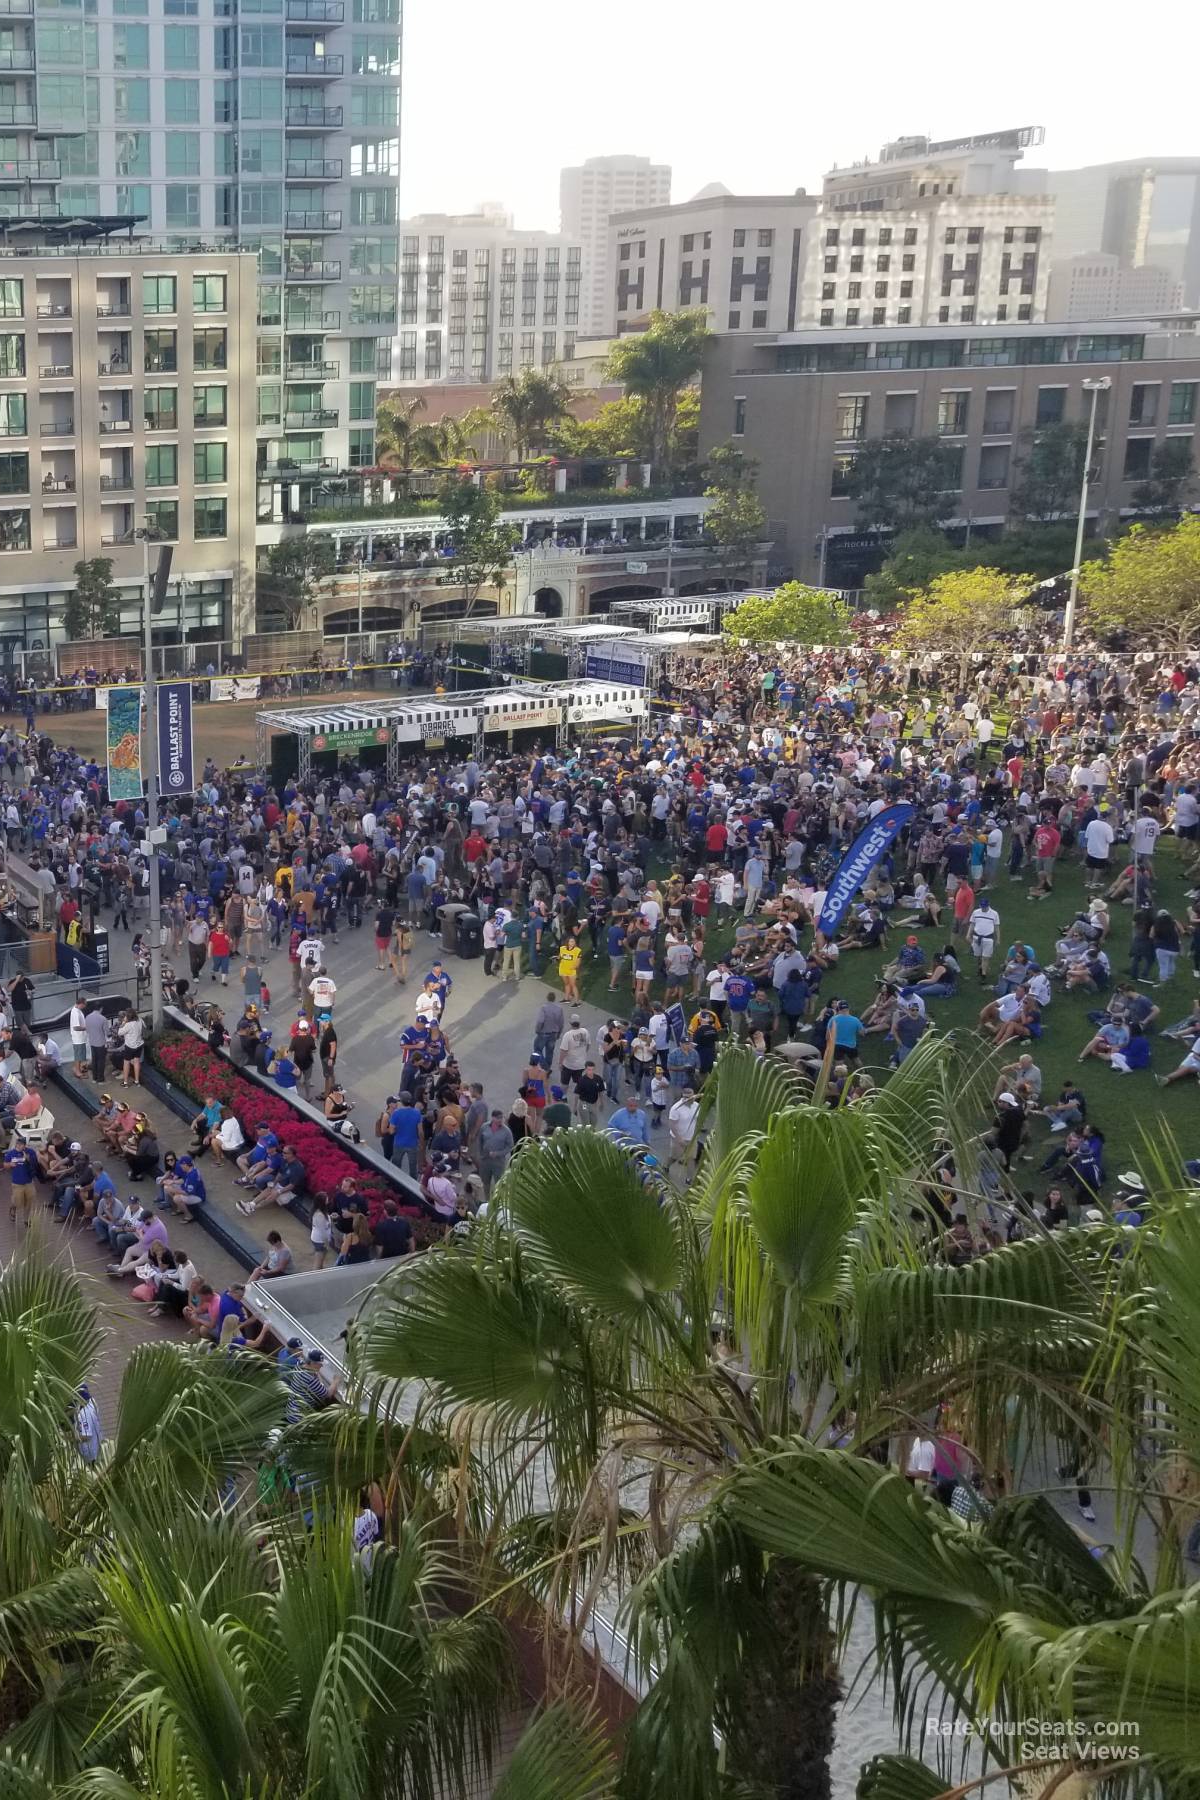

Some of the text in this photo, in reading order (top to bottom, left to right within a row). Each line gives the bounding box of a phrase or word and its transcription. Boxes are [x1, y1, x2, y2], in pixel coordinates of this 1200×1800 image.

[170, 692, 180, 770] BALLAST POINT
[329, 730, 374, 741] BRECKENRIDGE
[337, 738, 366, 748] BREWERY
[242, 872, 250, 880] 14
[822, 826, 891, 924] Southwest
